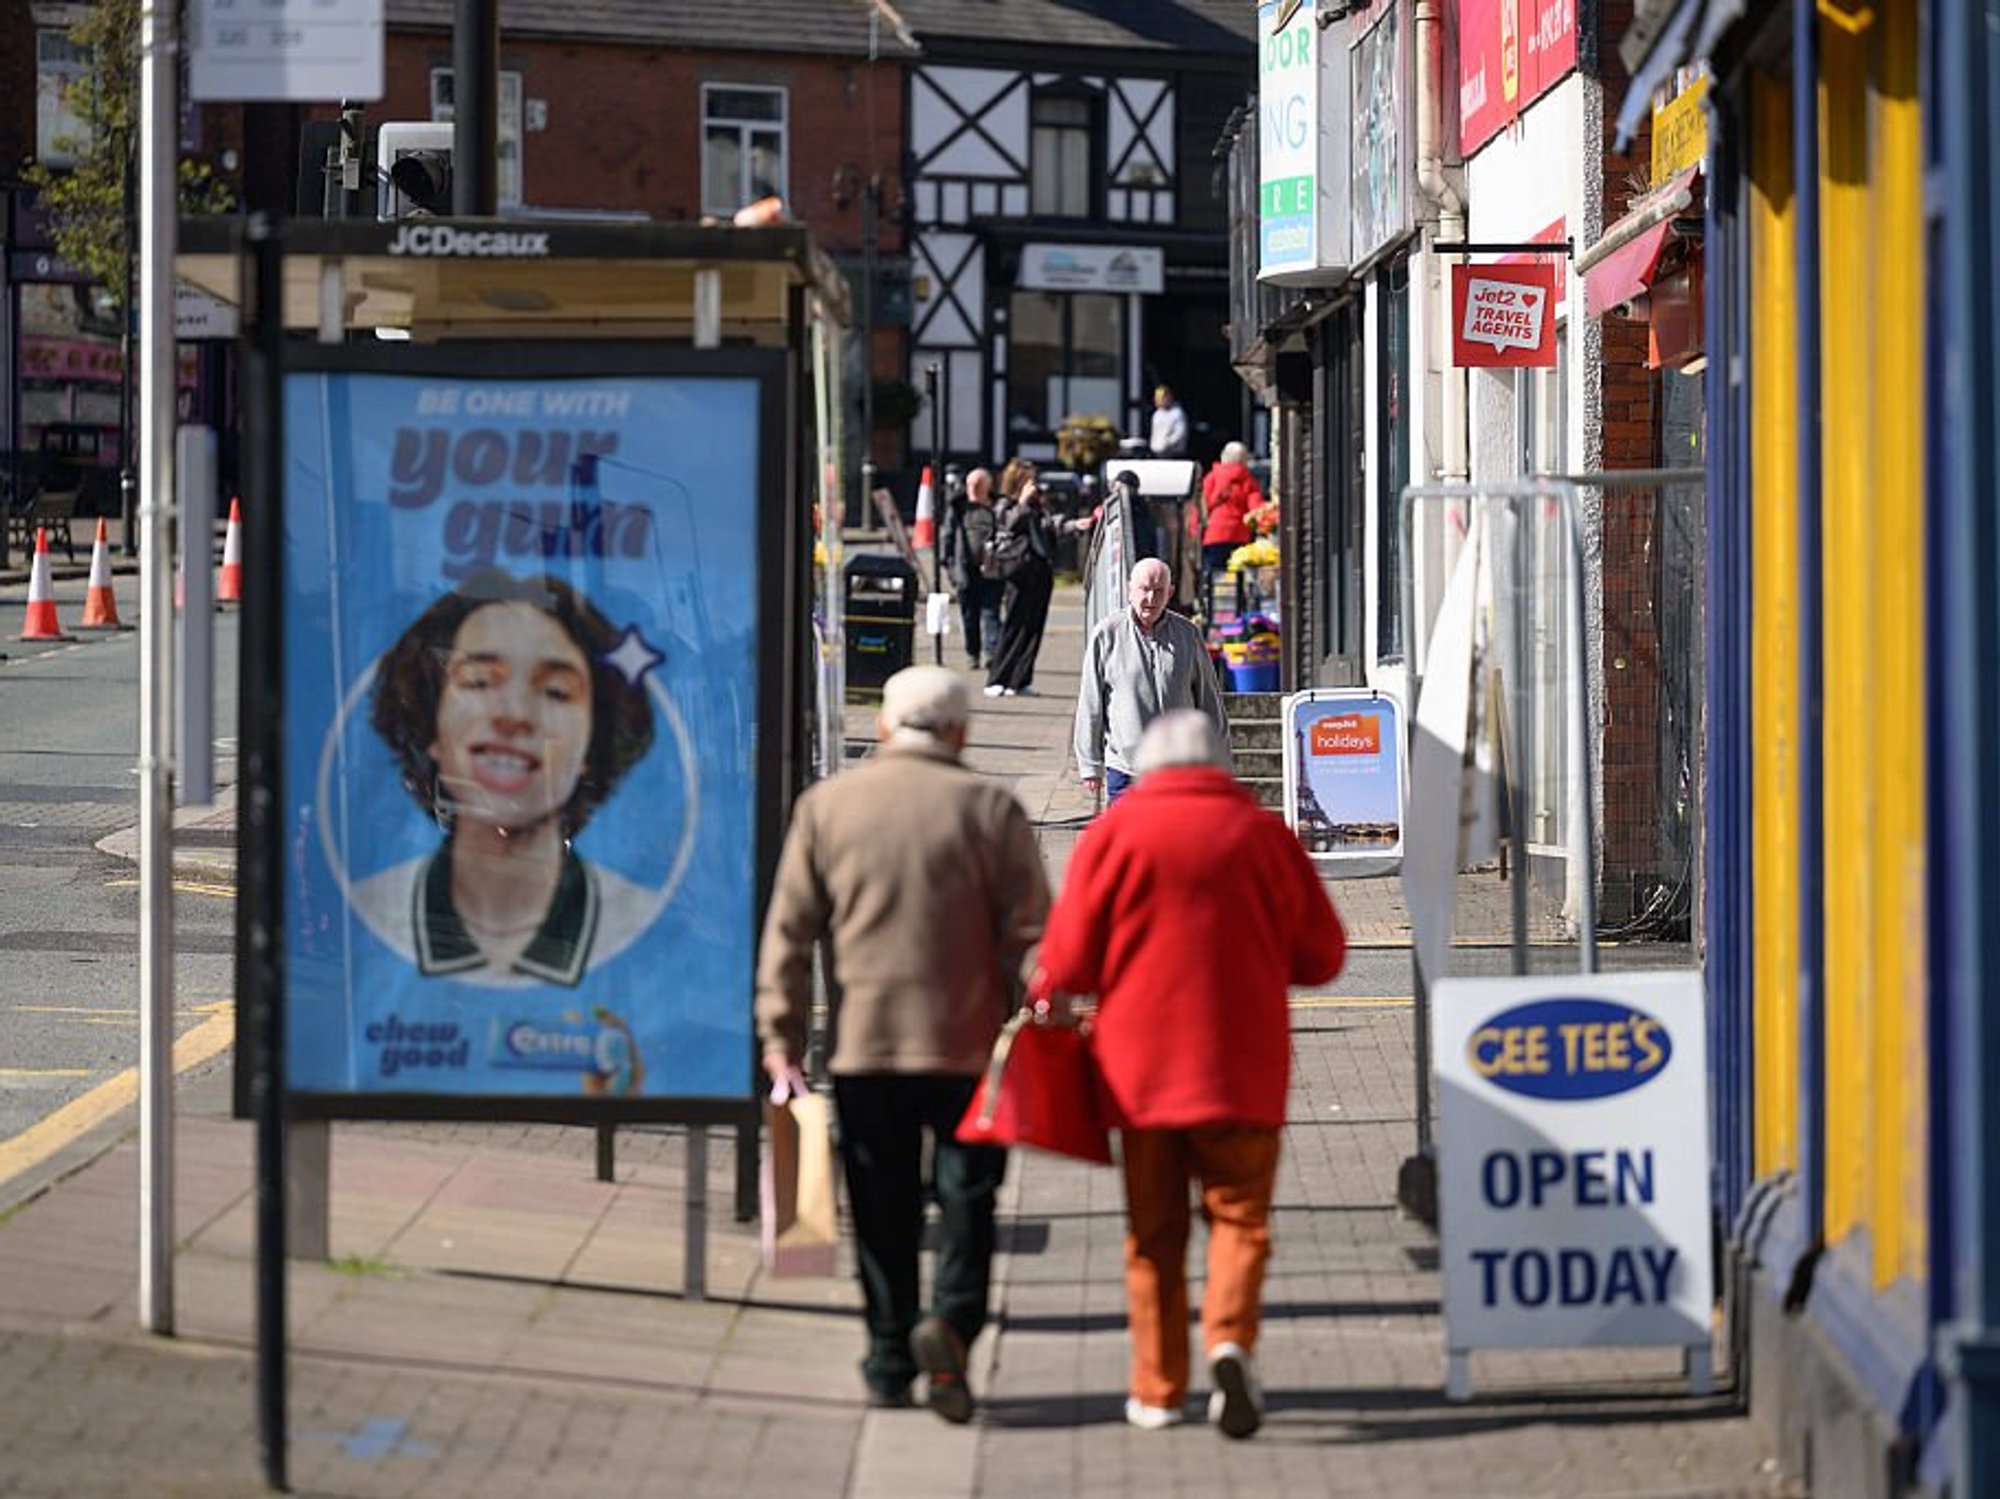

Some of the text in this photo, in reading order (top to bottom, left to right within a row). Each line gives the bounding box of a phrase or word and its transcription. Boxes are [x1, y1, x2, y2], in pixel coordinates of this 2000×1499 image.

[388, 226, 549, 255] JCDecaux
[1474, 288, 1516, 306] Jet2
[1471, 320, 1533, 340] AGENTS
[1475, 306, 1532, 326] TRAVEL
[416, 388, 633, 418] BE ONE WITH
[388, 427, 620, 510] your
[441, 499, 650, 580] gum
[1316, 732, 1375, 750] holidays
[366, 1013, 459, 1044] chew
[379, 1038, 472, 1078] good
[1466, 1014, 1663, 1078] GEE TEE'S
[1481, 1148, 1655, 1210] OPEN
[1469, 1247, 1679, 1308] TODAY
